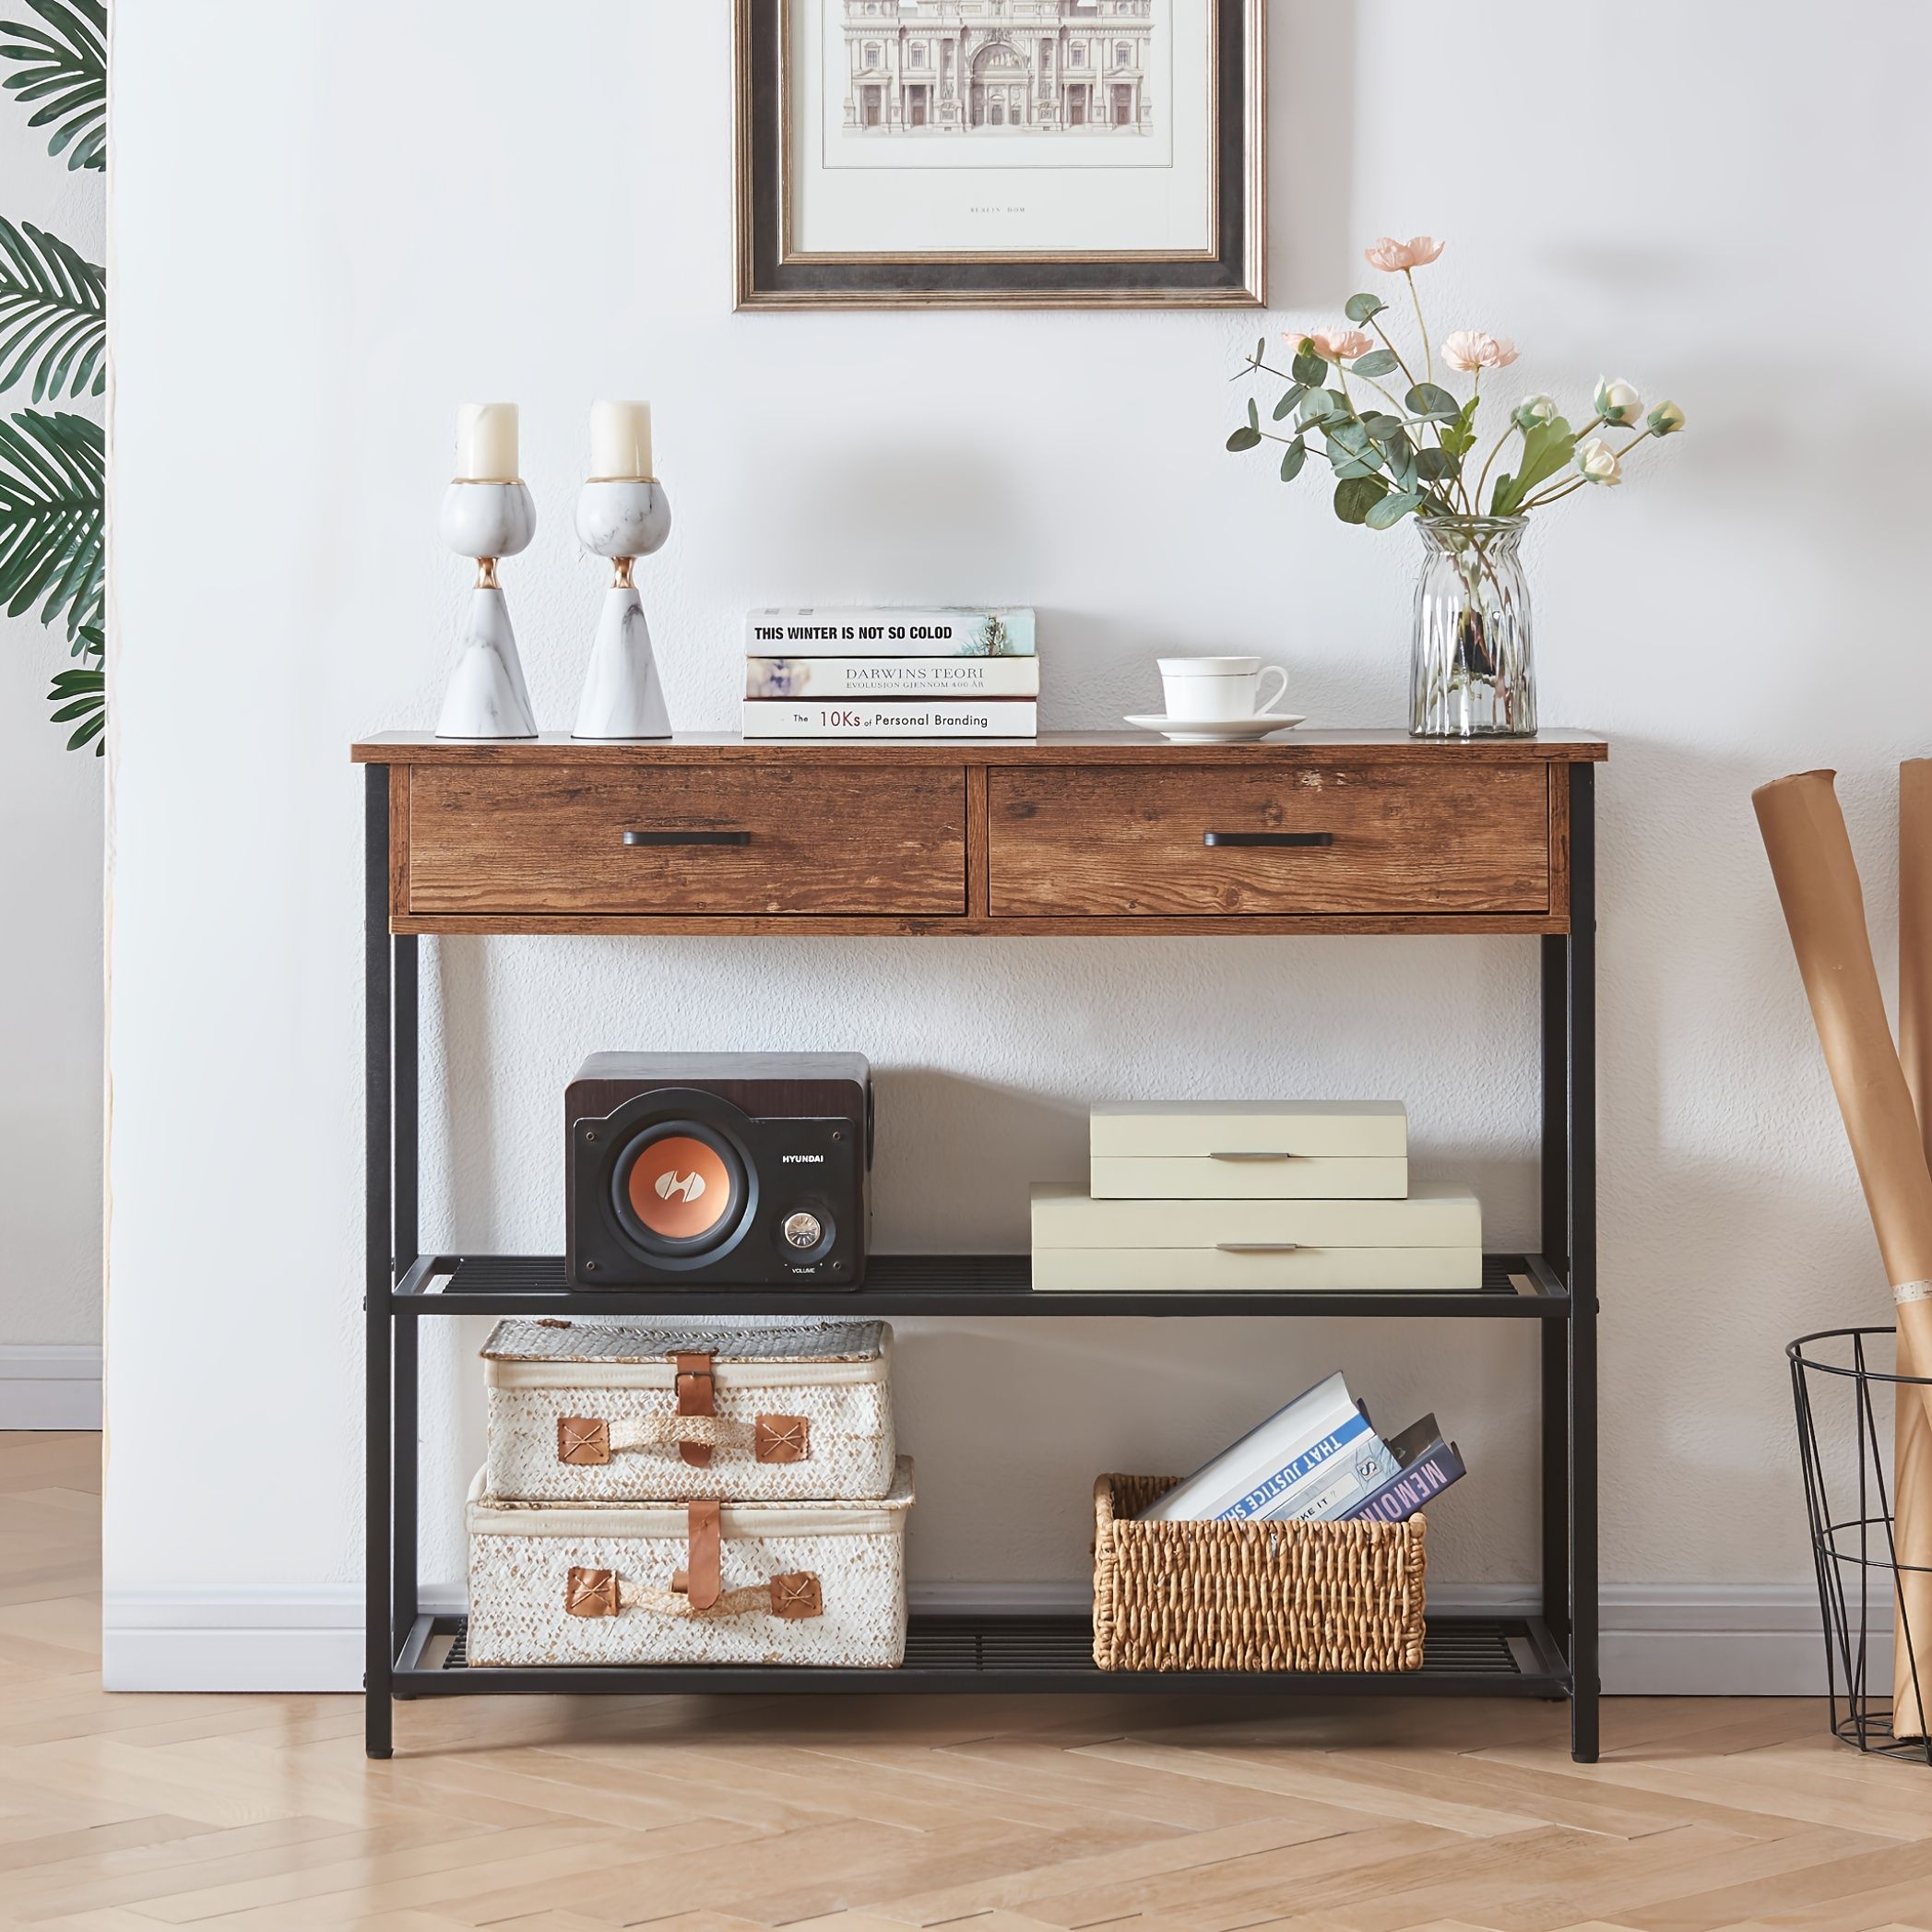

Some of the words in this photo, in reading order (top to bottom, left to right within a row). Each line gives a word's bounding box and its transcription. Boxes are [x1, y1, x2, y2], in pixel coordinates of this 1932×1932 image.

[754, 627, 784, 640] THIS
[787, 627, 837, 640] WINTER
[841, 627, 855, 640] IS
[859, 626, 884, 639] NOT
[888, 626, 906, 639] SO
[909, 626, 953, 639] COLOD
[846, 668, 927, 680] DARWINS
[930, 668, 983, 679] TEORI
[793, 714, 809, 722] The
[821, 711, 860, 727] 10Ks
[863, 718, 871, 727] of
[875, 714, 929, 726] Personal
[934, 715, 989, 729] Branding
[782, 1155, 824, 1163] HYUNDAI
[1303, 1436, 1343, 1471] THAT
[1245, 1462, 1302, 1511] JUSTICE
[1297, 1507, 1315, 1522] KE
[1317, 1497, 1329, 1509] IT
